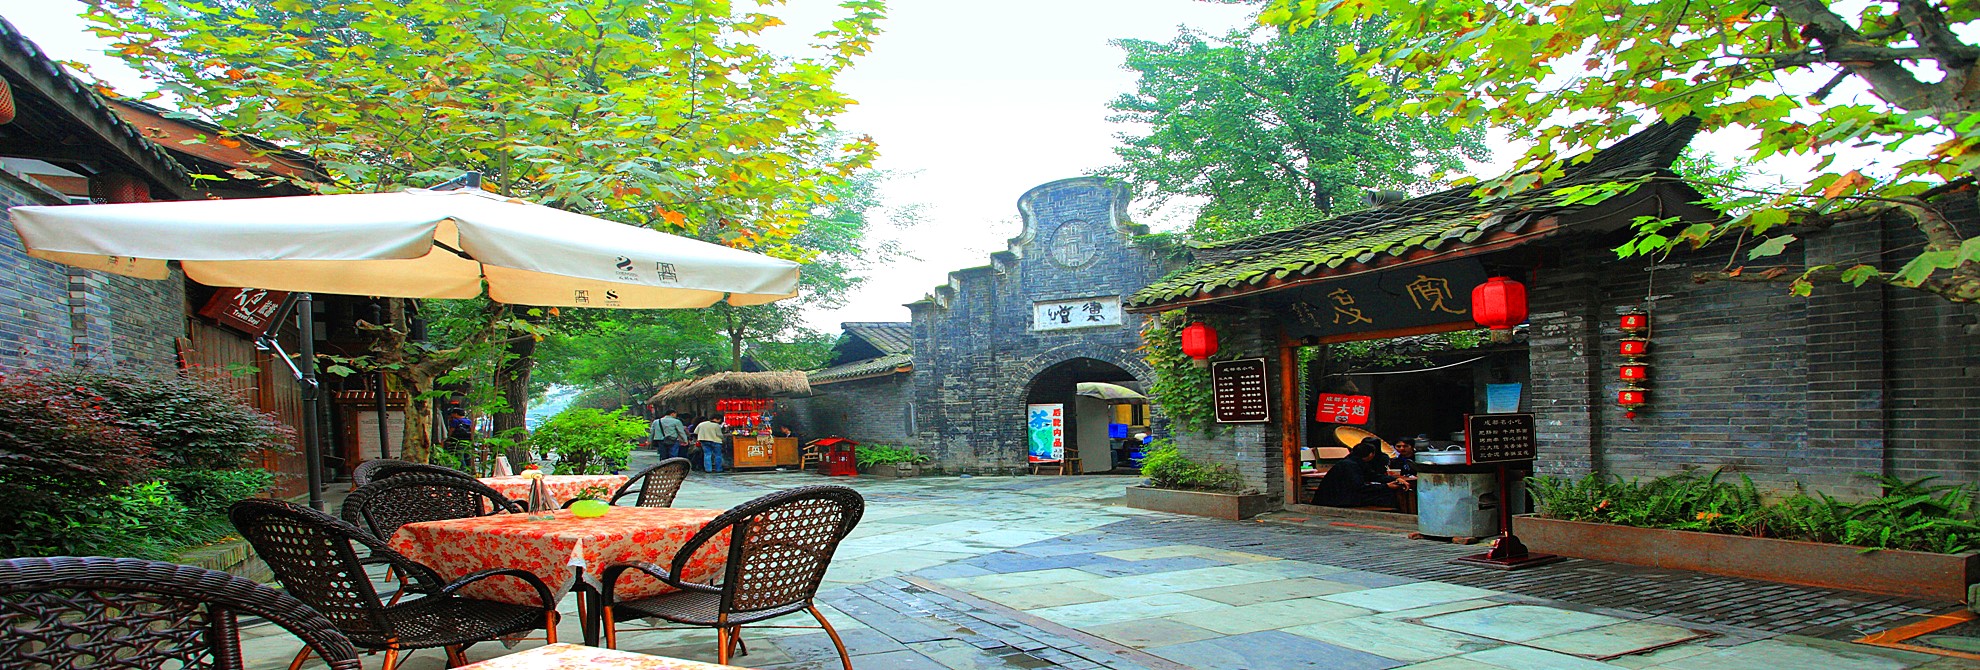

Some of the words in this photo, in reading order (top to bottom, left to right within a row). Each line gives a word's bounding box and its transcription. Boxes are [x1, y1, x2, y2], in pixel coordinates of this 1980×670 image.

[232, 309, 249, 321] Travel
[1326, 396, 1364, 404] 成都名小吃
[1321, 403, 1365, 416] 三大炮
[1028, 409, 1053, 429] 茶
